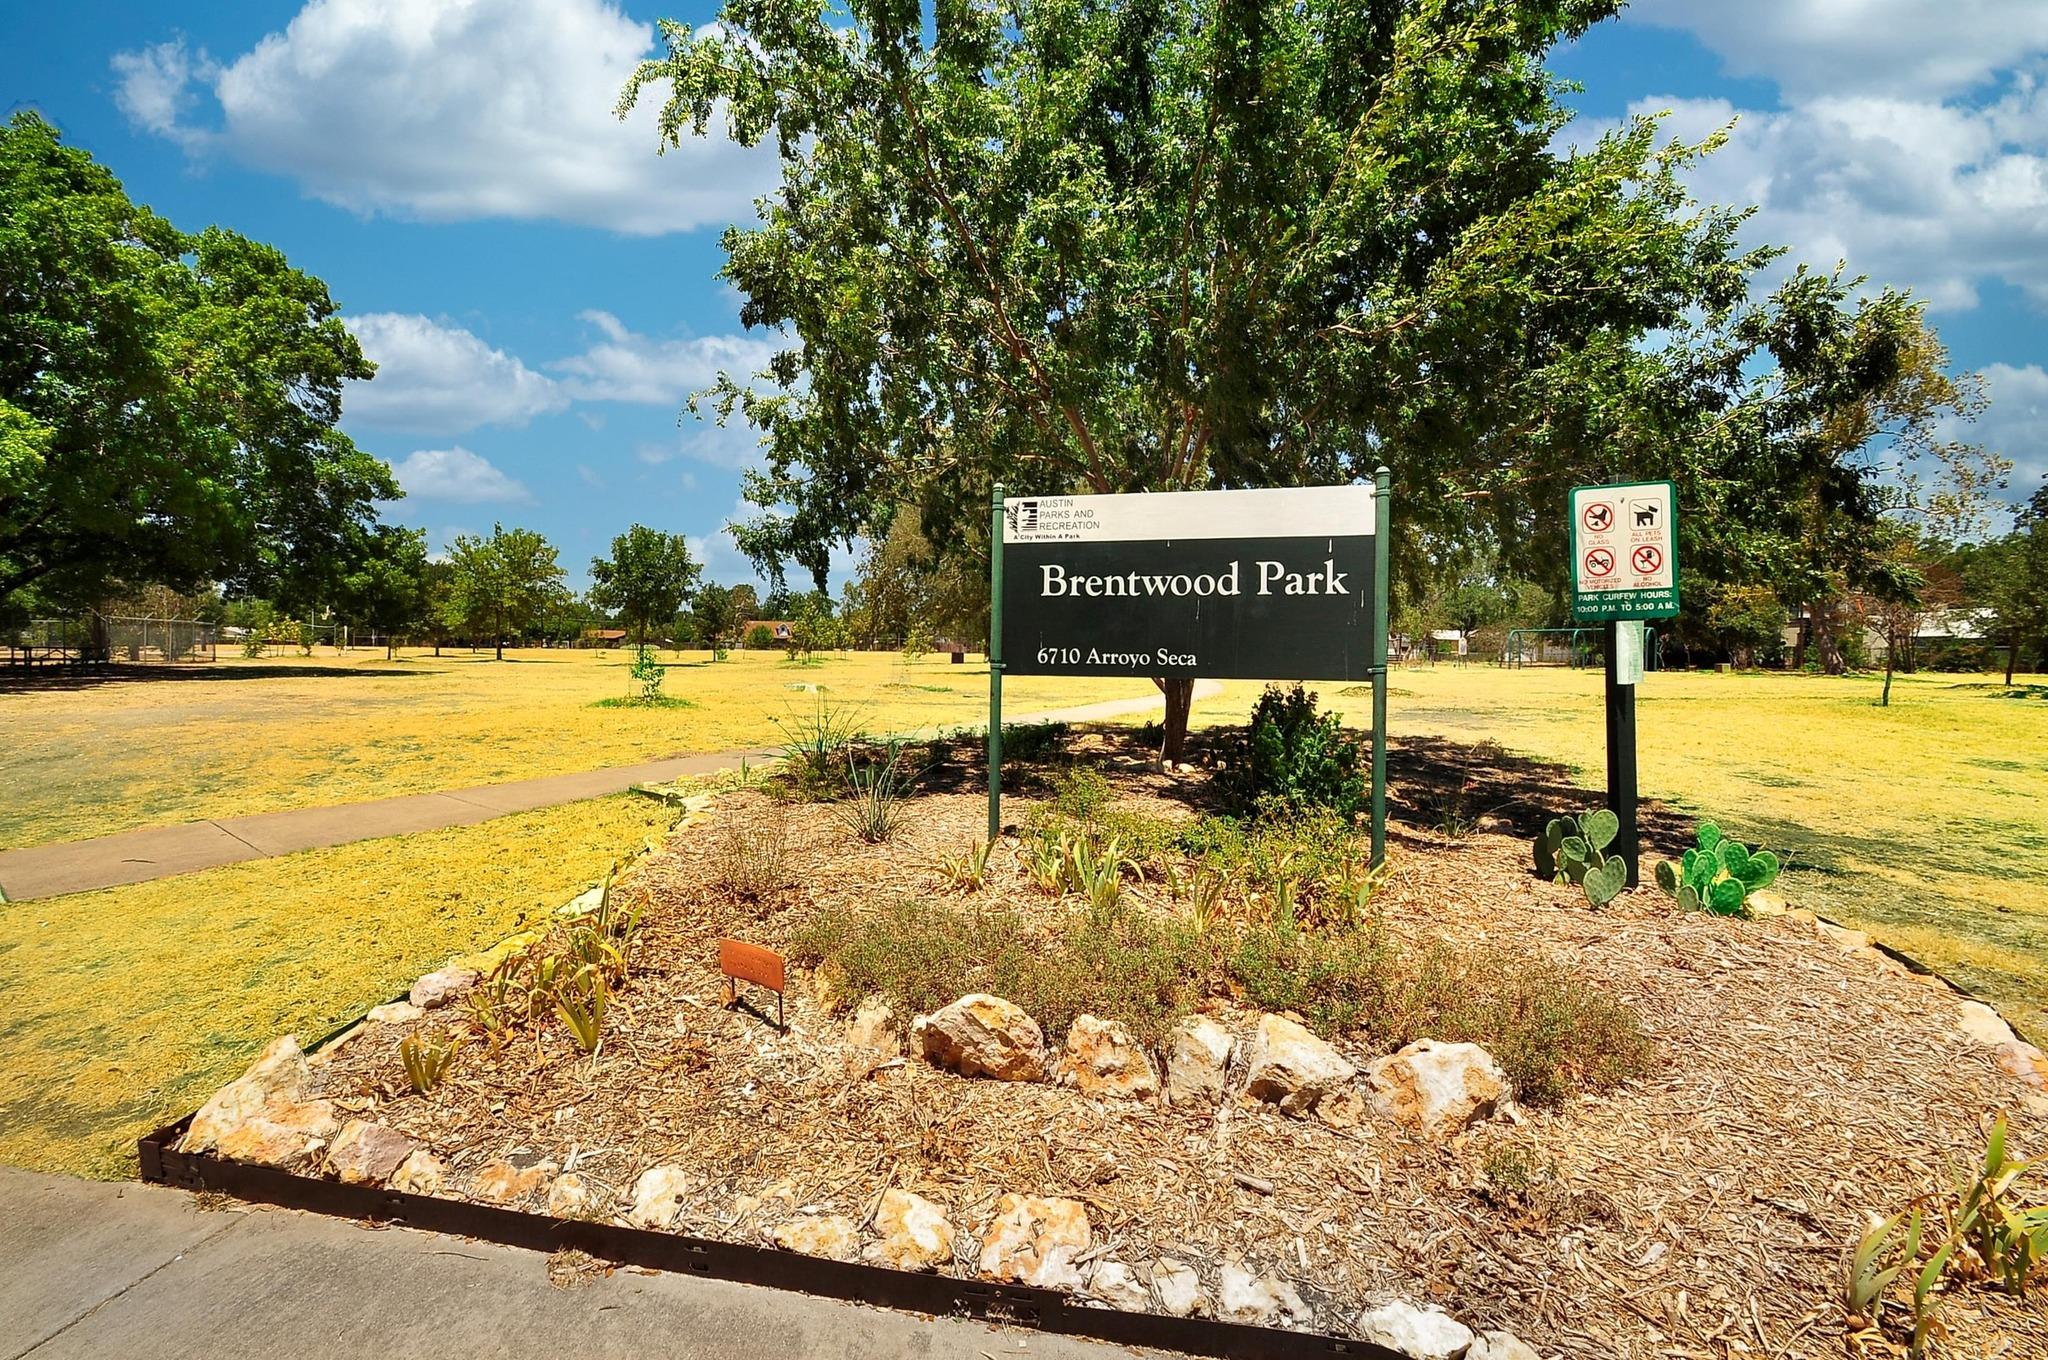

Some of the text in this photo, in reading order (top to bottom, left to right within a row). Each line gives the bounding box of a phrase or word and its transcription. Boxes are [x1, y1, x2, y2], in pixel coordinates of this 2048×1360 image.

[1040, 499, 1073, 508] AUSTIN
[1039, 509, 1094, 519] PARKS AND
[1039, 521, 1100, 530] RECREATION
[1039, 559, 1350, 597] Brentwood Park
[1578, 591, 1673, 602] PARK CURFEW HOURS:
[1577, 605, 1599, 613] 10:00
[1601, 604, 1617, 612] P.M.
[1621, 603, 1632, 611] TO
[1635, 603, 1655, 611] 5:00
[1037, 648, 1198, 669] 6710 Arroyo Seca
